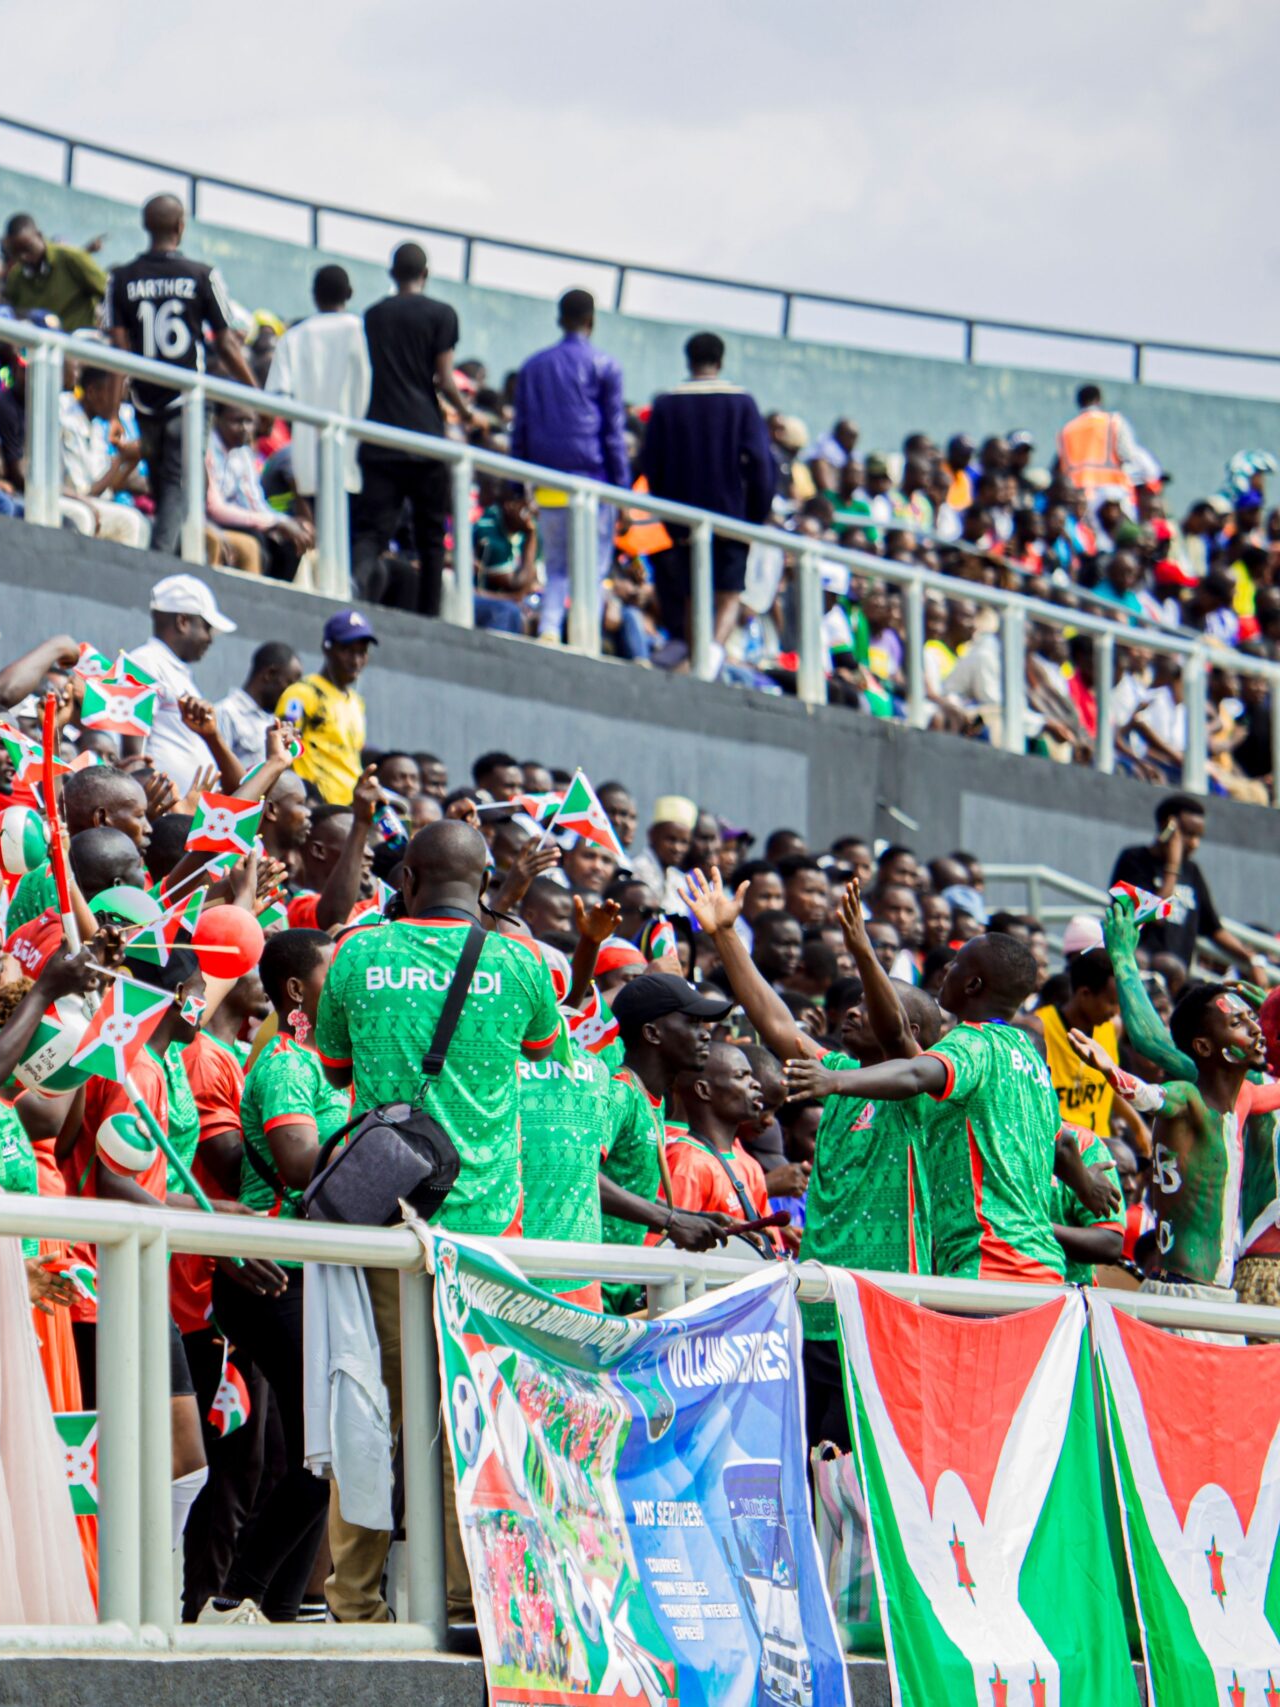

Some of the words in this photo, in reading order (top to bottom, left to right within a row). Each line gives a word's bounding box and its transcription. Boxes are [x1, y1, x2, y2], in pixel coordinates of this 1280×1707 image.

[127, 278, 196, 300] BARTHEZ
[137, 300, 191, 358] 16
[366, 966, 502, 995] BURUDI
[519, 1061, 593, 1082] RUNDI
[1056, 1081, 1107, 1108] FURY
[500, 1292, 549, 1327] FANS
[532, 1304, 598, 1342] BURUNDI
[632, 1500, 655, 1526] NOS
